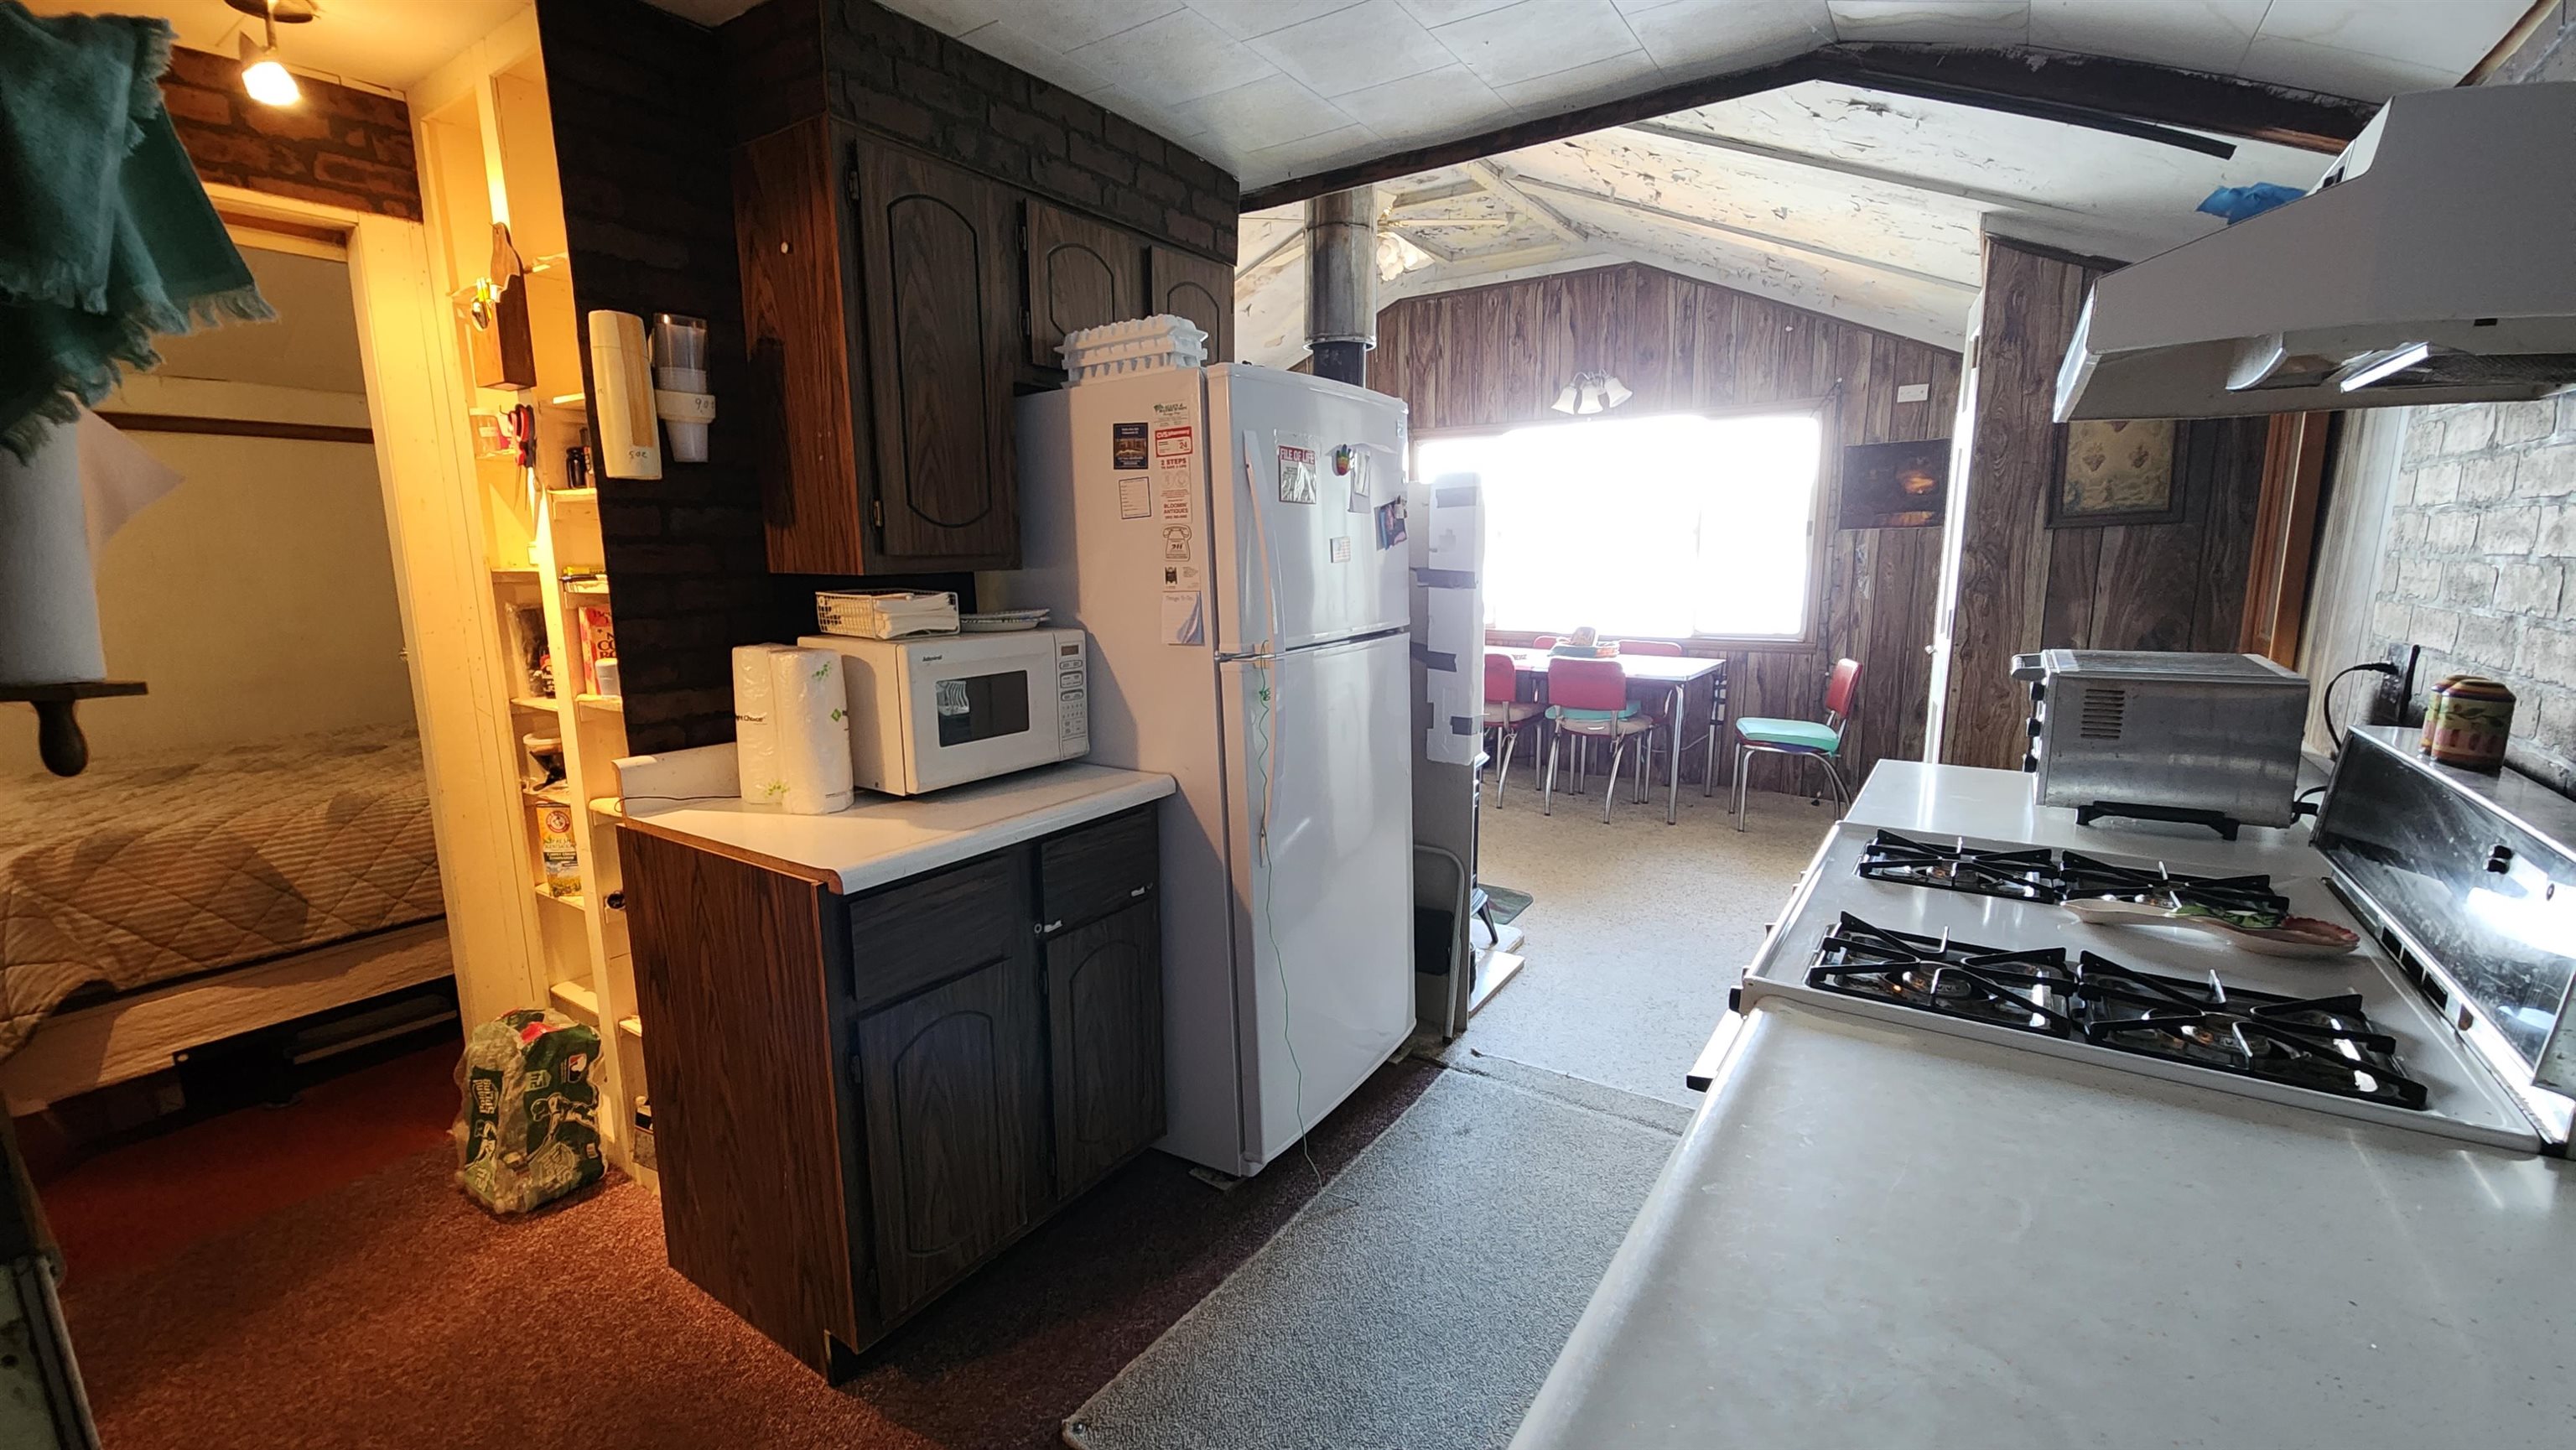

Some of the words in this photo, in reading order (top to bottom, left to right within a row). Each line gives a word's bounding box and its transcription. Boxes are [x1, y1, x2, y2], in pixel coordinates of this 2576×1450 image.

[1280, 448, 1293, 460] FILE
[1293, 450, 1301, 462] OF
[1302, 450, 1315, 464] LIFE
